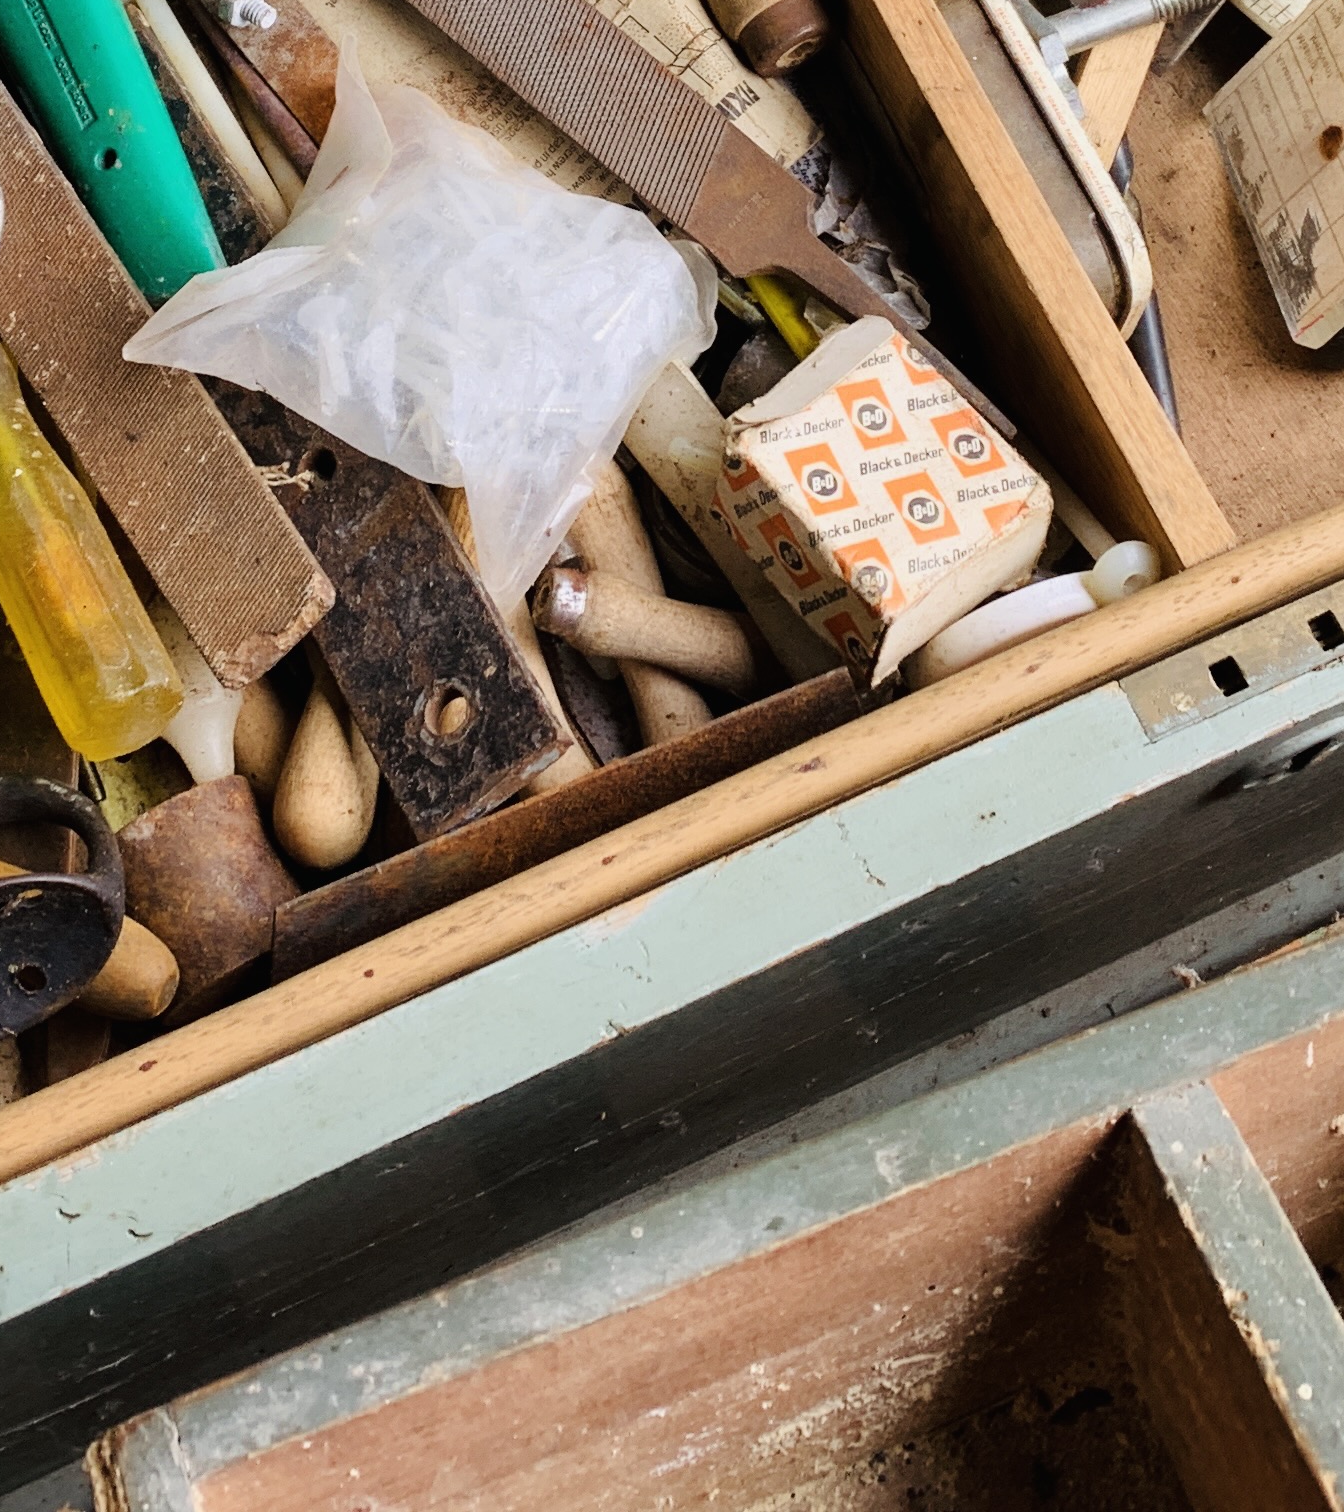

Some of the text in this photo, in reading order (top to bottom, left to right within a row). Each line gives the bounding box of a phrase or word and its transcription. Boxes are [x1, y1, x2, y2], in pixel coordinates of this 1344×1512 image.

[906, 392, 942, 413] Black
[803, 416, 845, 437] Decker
[859, 459, 895, 476] Black
[903, 448, 945, 466] Decker
[957, 486, 991, 503] Black
[852, 511, 896, 532] Decker
[907, 557, 942, 575] Black
